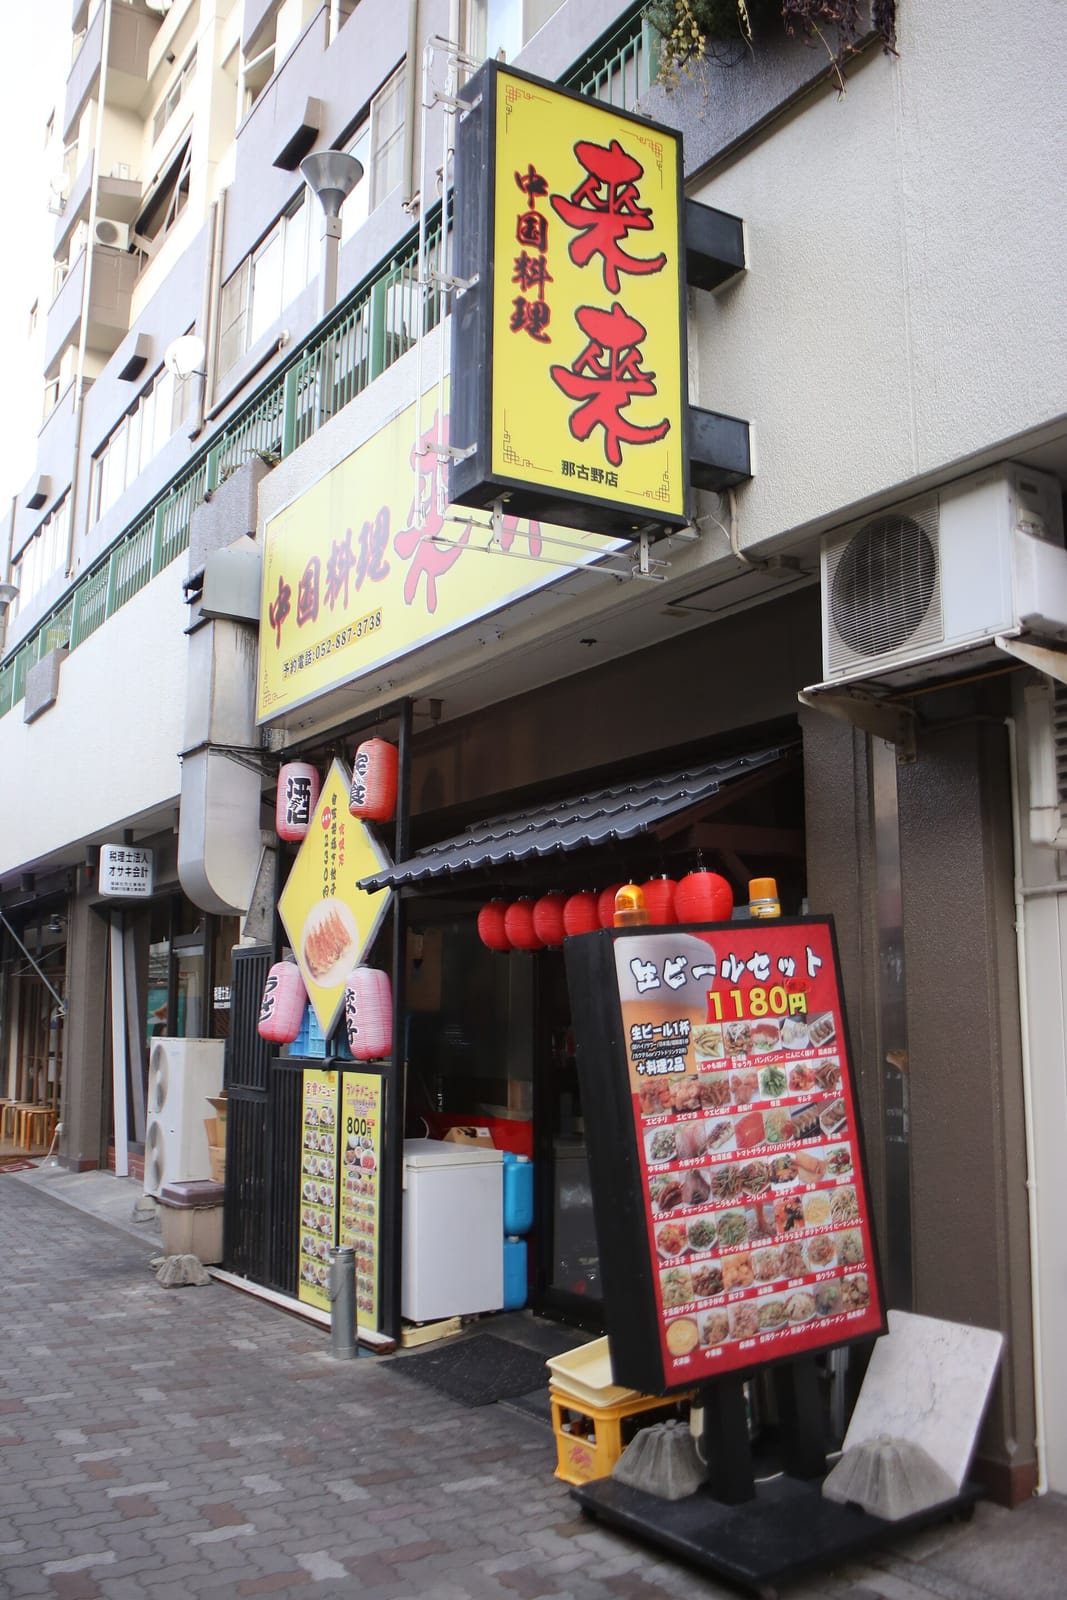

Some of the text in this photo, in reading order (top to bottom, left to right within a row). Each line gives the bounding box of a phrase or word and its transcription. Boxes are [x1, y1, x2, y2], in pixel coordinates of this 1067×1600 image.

[509, 163, 554, 345] 中国料理
[561, 460, 619, 488] 那古野店
[269, 505, 391, 649] 中国料理
[109, 850, 149, 863] 税理士法人
[109, 866, 149, 878] オサキ会計
[630, 945, 823, 993] 生ビールセット
[709, 983, 807, 1023] 1180円
[630, 1020, 691, 1040] 生ビール1杯
[347, 1117, 371, 1138] 800円
